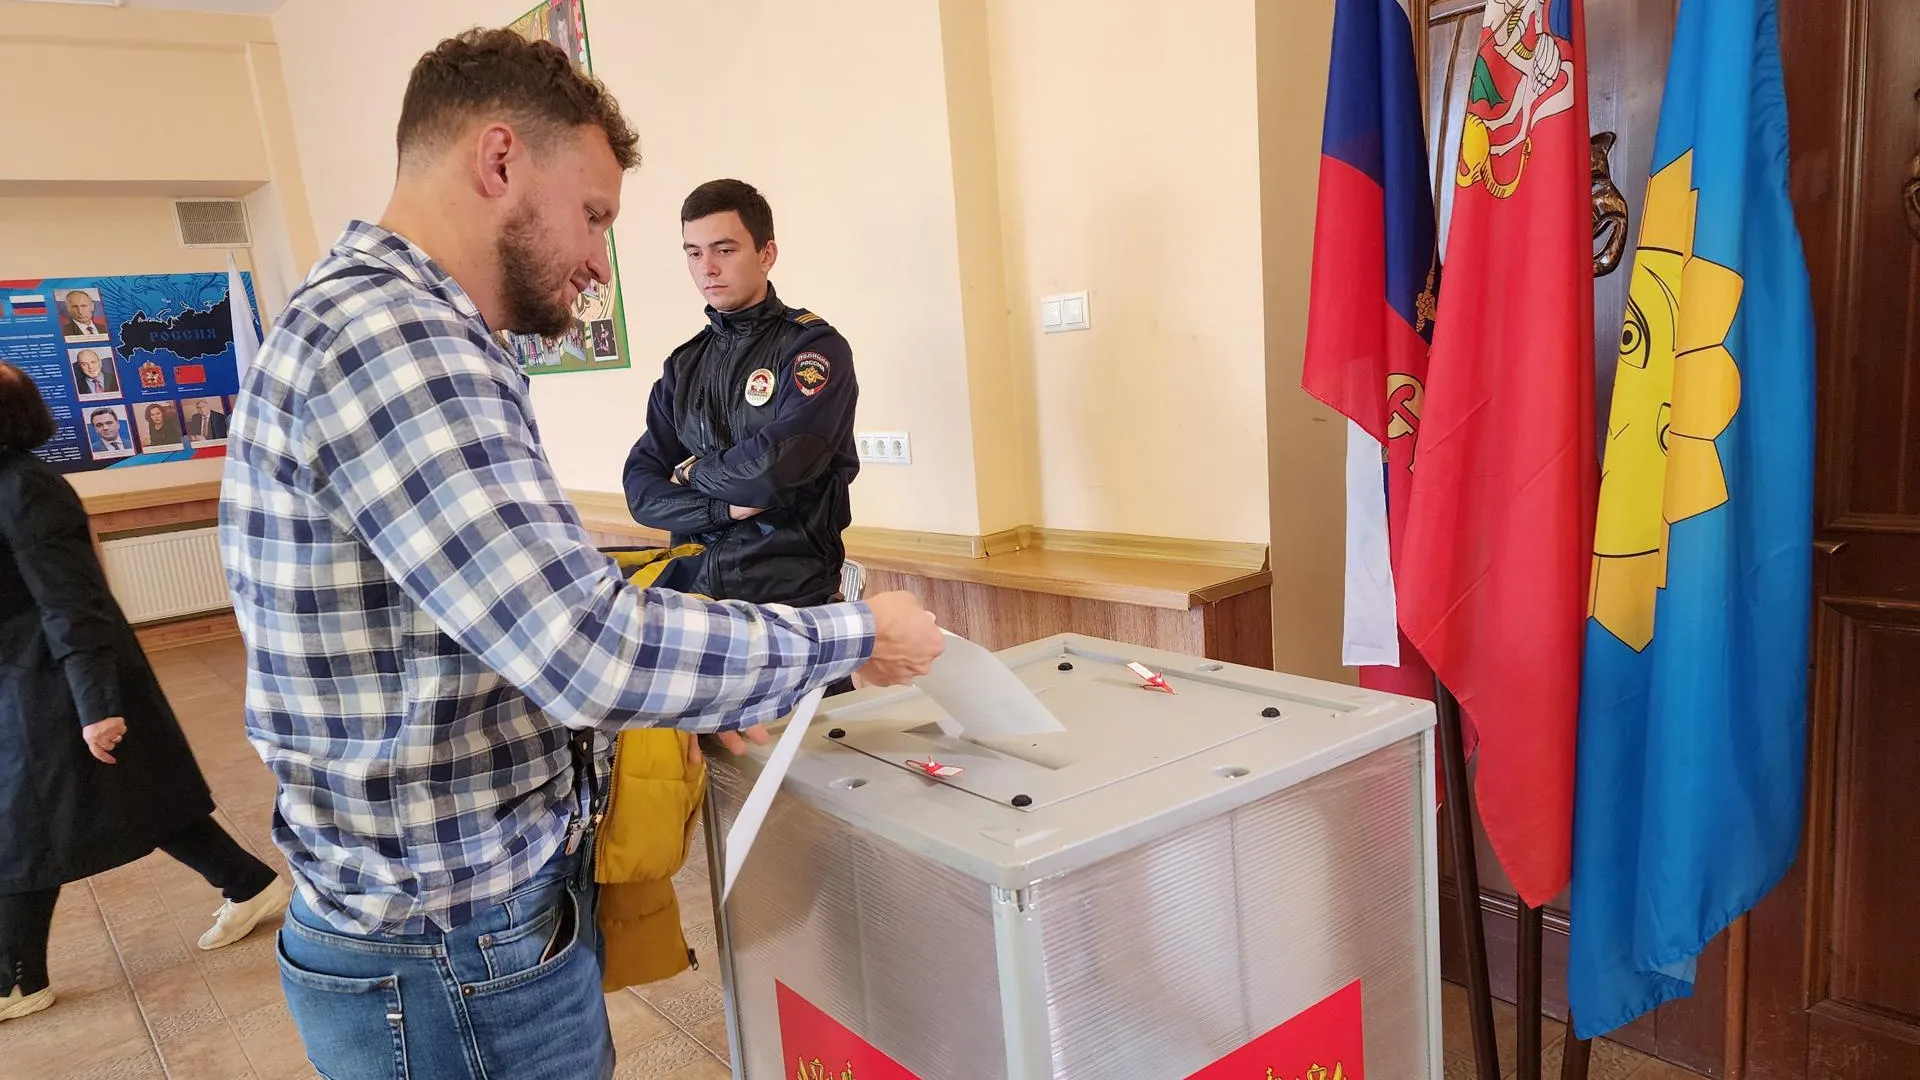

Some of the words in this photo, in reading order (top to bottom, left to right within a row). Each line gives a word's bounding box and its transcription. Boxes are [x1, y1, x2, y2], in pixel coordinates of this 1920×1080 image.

[148, 328, 217, 342] РОССИЯ
[797, 353, 829, 368] ПОЛИЦИЯ
[800, 360, 825, 373] РОССИЯ
